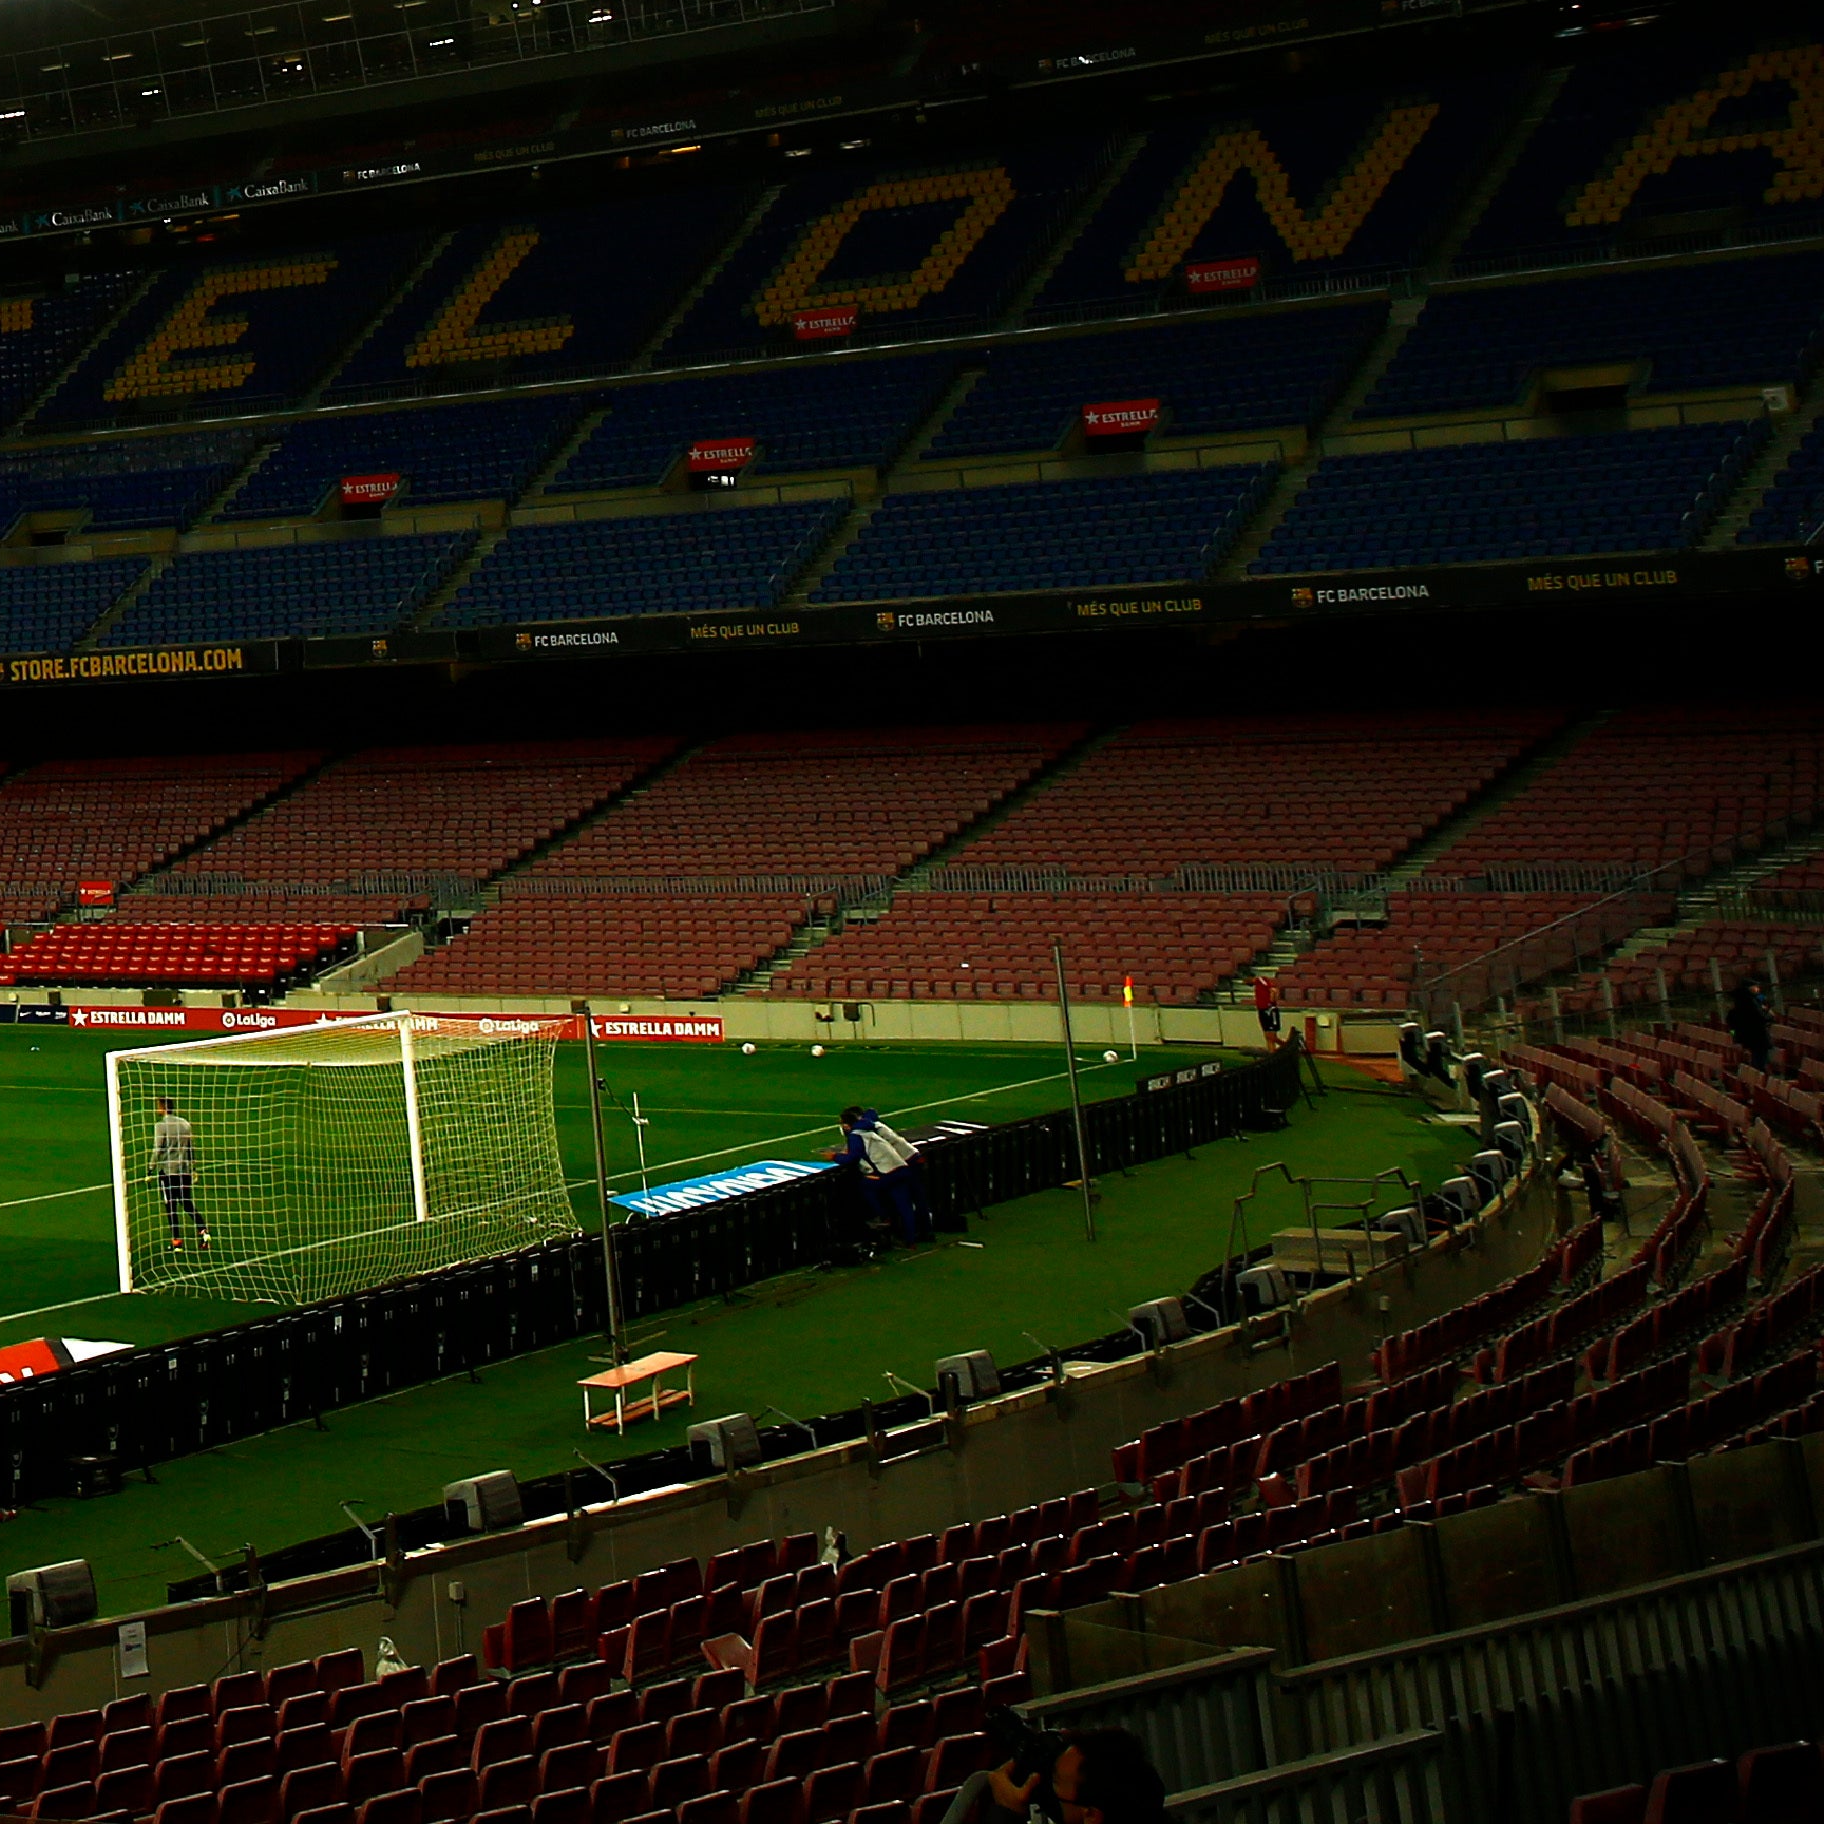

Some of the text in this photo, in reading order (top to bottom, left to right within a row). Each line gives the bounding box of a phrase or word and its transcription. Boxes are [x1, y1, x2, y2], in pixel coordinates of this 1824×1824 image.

[357, 162, 421, 180] FC BARCELONA
[244, 177, 309, 198] CaixaBank
[147, 192, 209, 212] CaixaBank
[52, 208, 113, 227] CaixaBank
[1527, 570, 1679, 591] MÉS QUE UN CLUB
[1317, 585, 1429, 604] FC BARCELONA
[1078, 598, 1203, 616] MÉS QUE UN CLUB
[898, 610, 994, 628] FC BARCELONA
[691, 622, 800, 639] MÉS QUE UN CLUB
[534, 632, 618, 648] FC BARCELONA
[10, 648, 243, 682] STORE.FCBARCELONA.COM
[91, 1012, 185, 1024] ESTRELLA DAMM
[237, 1013, 275, 1026] LaLiga
[606, 1022, 720, 1036] ESTRELLA DAMM
